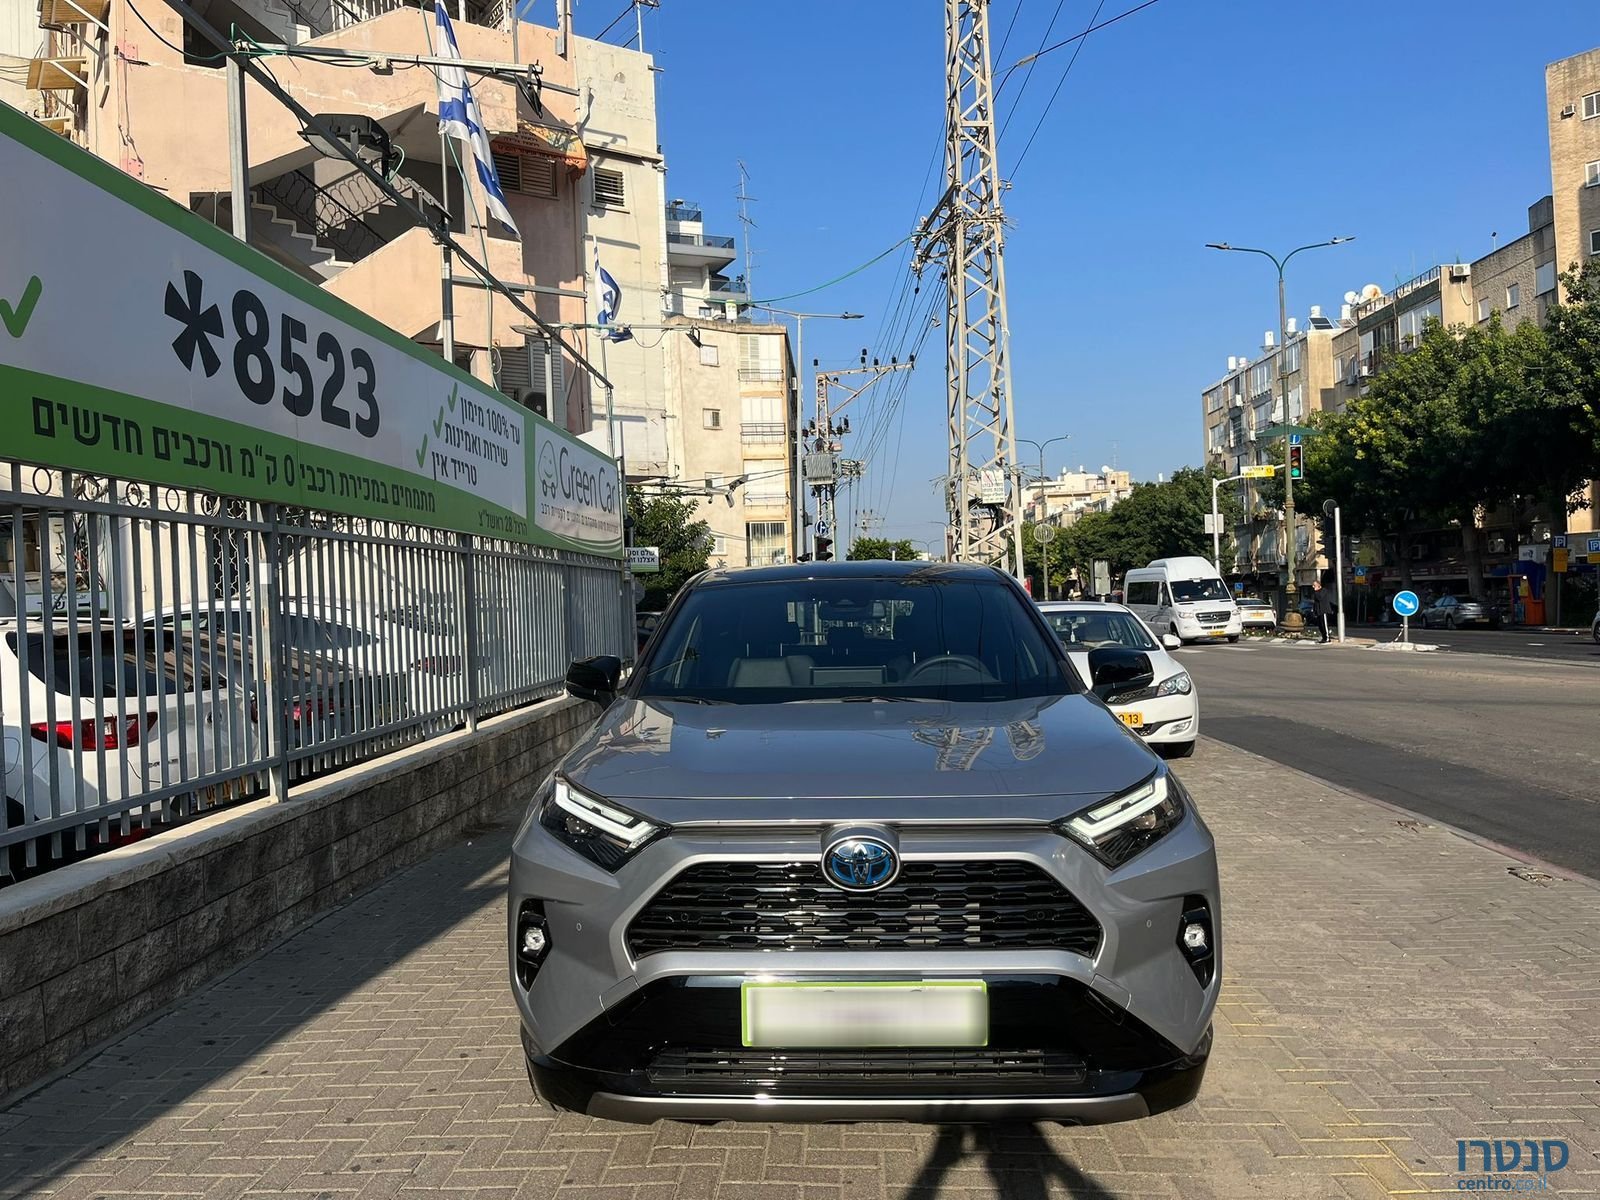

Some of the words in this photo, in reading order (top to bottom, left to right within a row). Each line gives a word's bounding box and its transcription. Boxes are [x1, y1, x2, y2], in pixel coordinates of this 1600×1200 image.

[31, 396, 143, 455] חדשים
[460, 397, 484, 428] מימון
[487, 408, 509, 439] 100%
[445, 422, 481, 456] ואמינות
[510, 423, 520, 445] עד
[152, 426, 233, 474] ורכבים
[431, 451, 448, 480] אין
[483, 439, 508, 467] שירות
[284, 453, 295, 487] 0
[300, 463, 336, 495] רכבי
[451, 457, 477, 486] טרייד
[559, 447, 598, 508] Green
[599, 464, 616, 515] Car
[339, 472, 389, 504] במכירת
[391, 484, 436, 513] מתמחים
